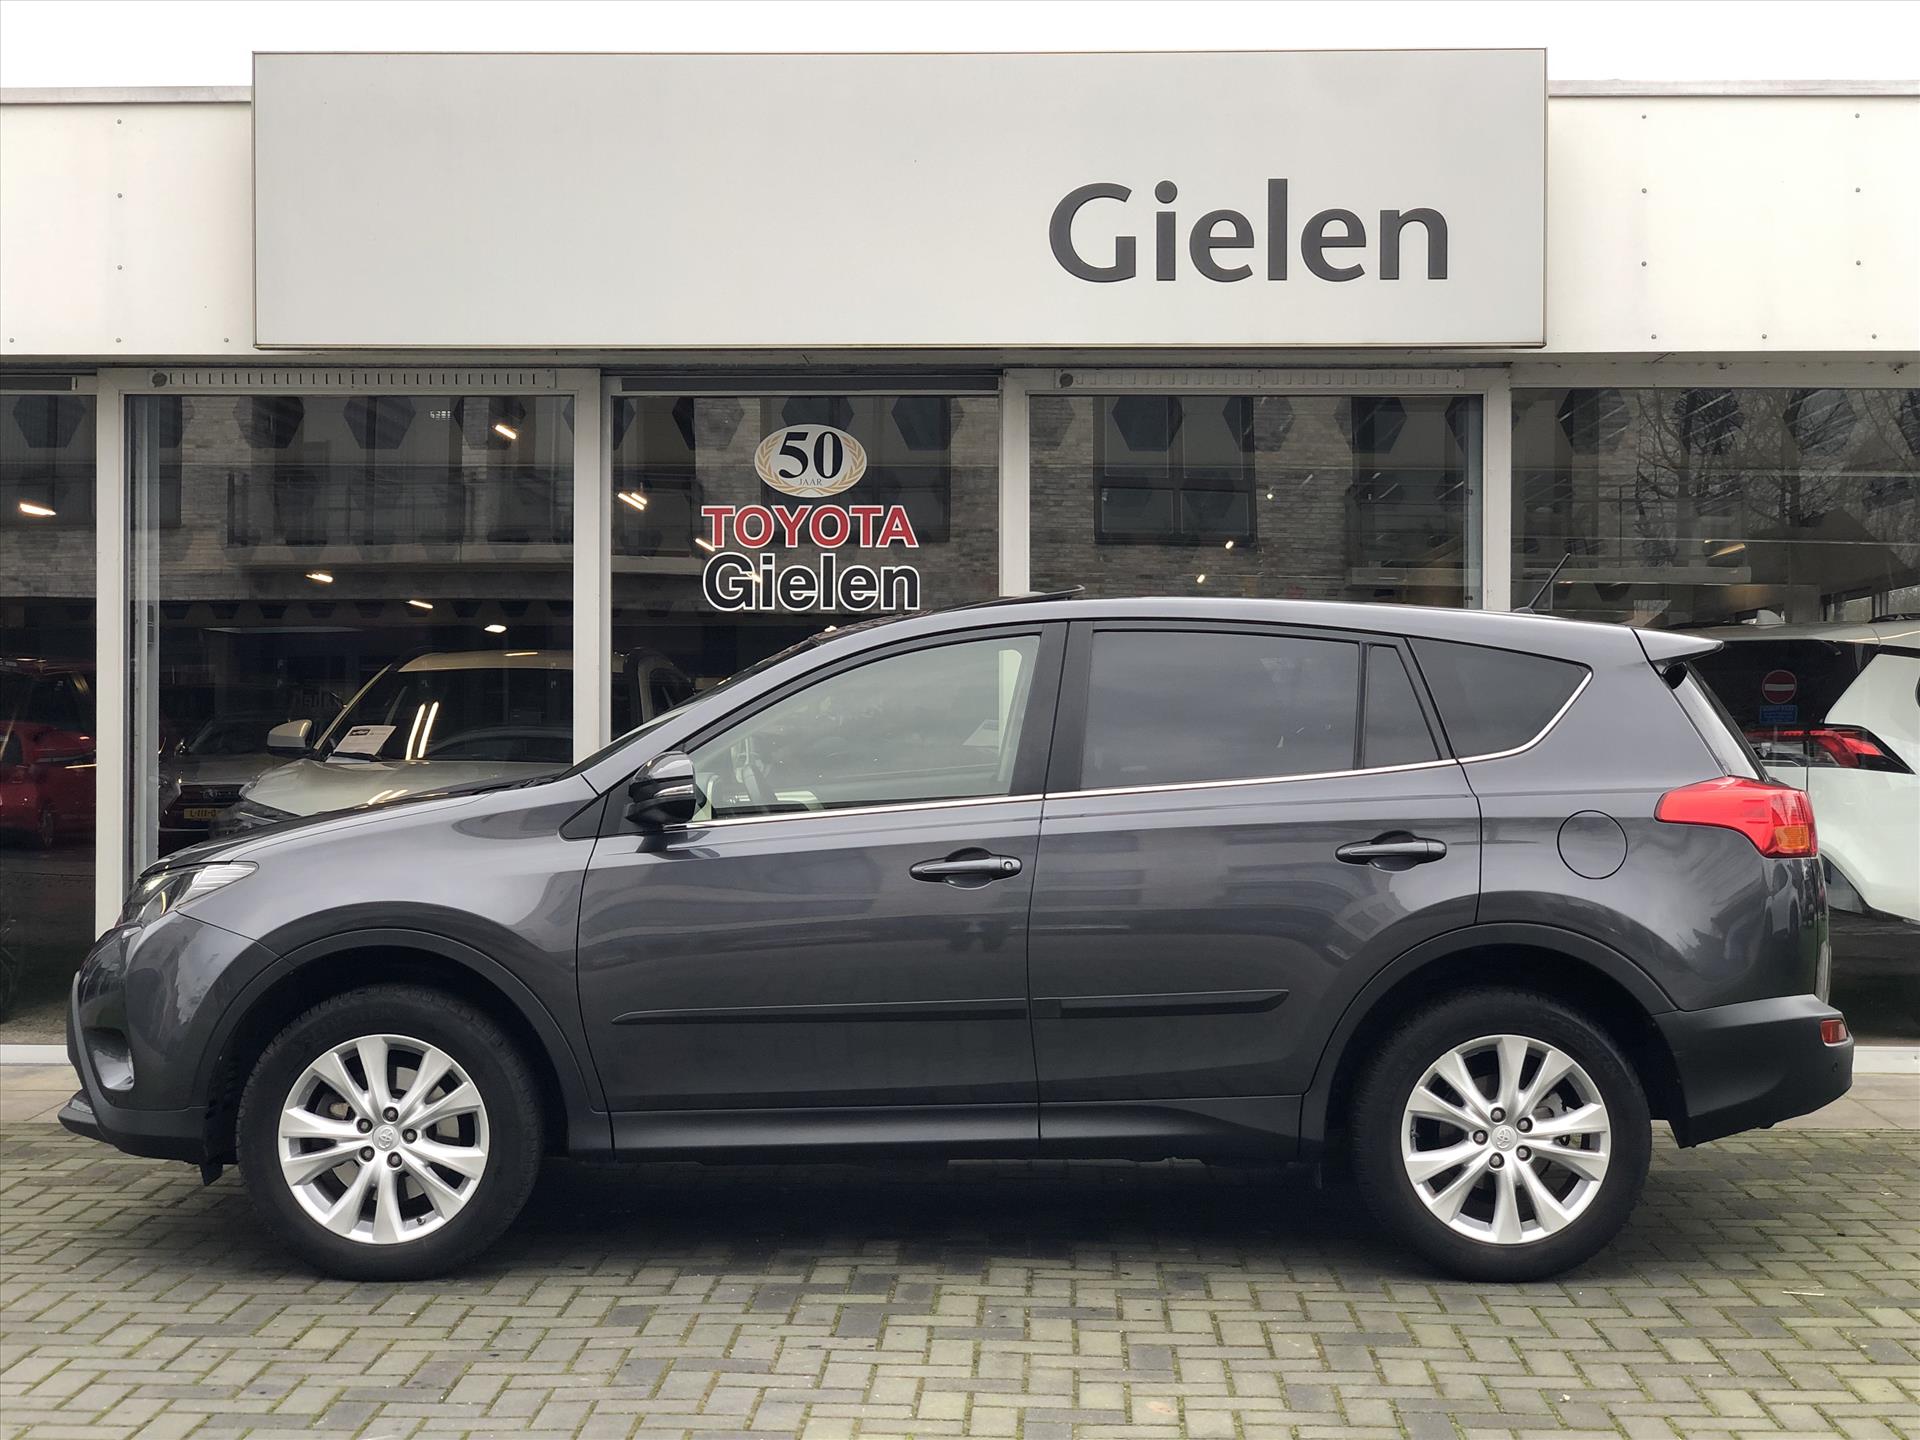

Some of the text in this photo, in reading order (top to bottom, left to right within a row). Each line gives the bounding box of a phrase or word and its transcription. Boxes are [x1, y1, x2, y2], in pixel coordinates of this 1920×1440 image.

[1048, 178, 1448, 283] Gielen
[778, 431, 843, 479] 50
[799, 478, 822, 486] JAAR
[701, 505, 919, 548] TOYOTA
[703, 551, 920, 611] Gielen
